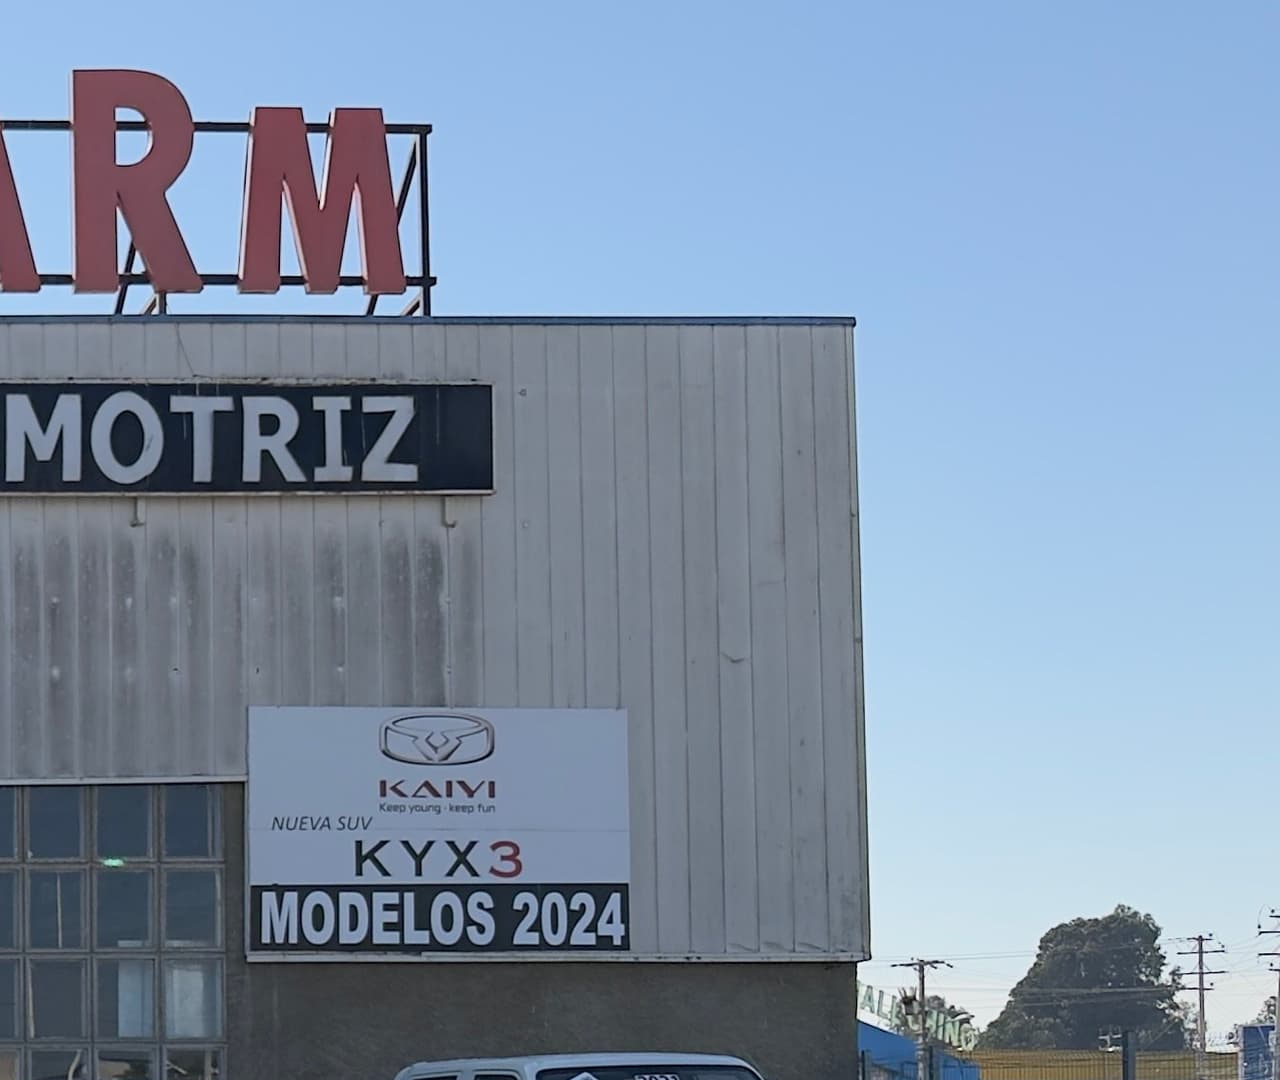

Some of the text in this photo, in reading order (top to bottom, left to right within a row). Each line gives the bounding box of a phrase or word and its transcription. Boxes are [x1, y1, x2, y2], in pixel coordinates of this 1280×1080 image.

[379, 779, 496, 799] KAIYI
[379, 803, 496, 815] Keep young keep fun
[271, 816, 373, 831] NUEVA SUV
[354, 839, 524, 879] KYX3
[260, 891, 626, 946] MODELOS 2024
